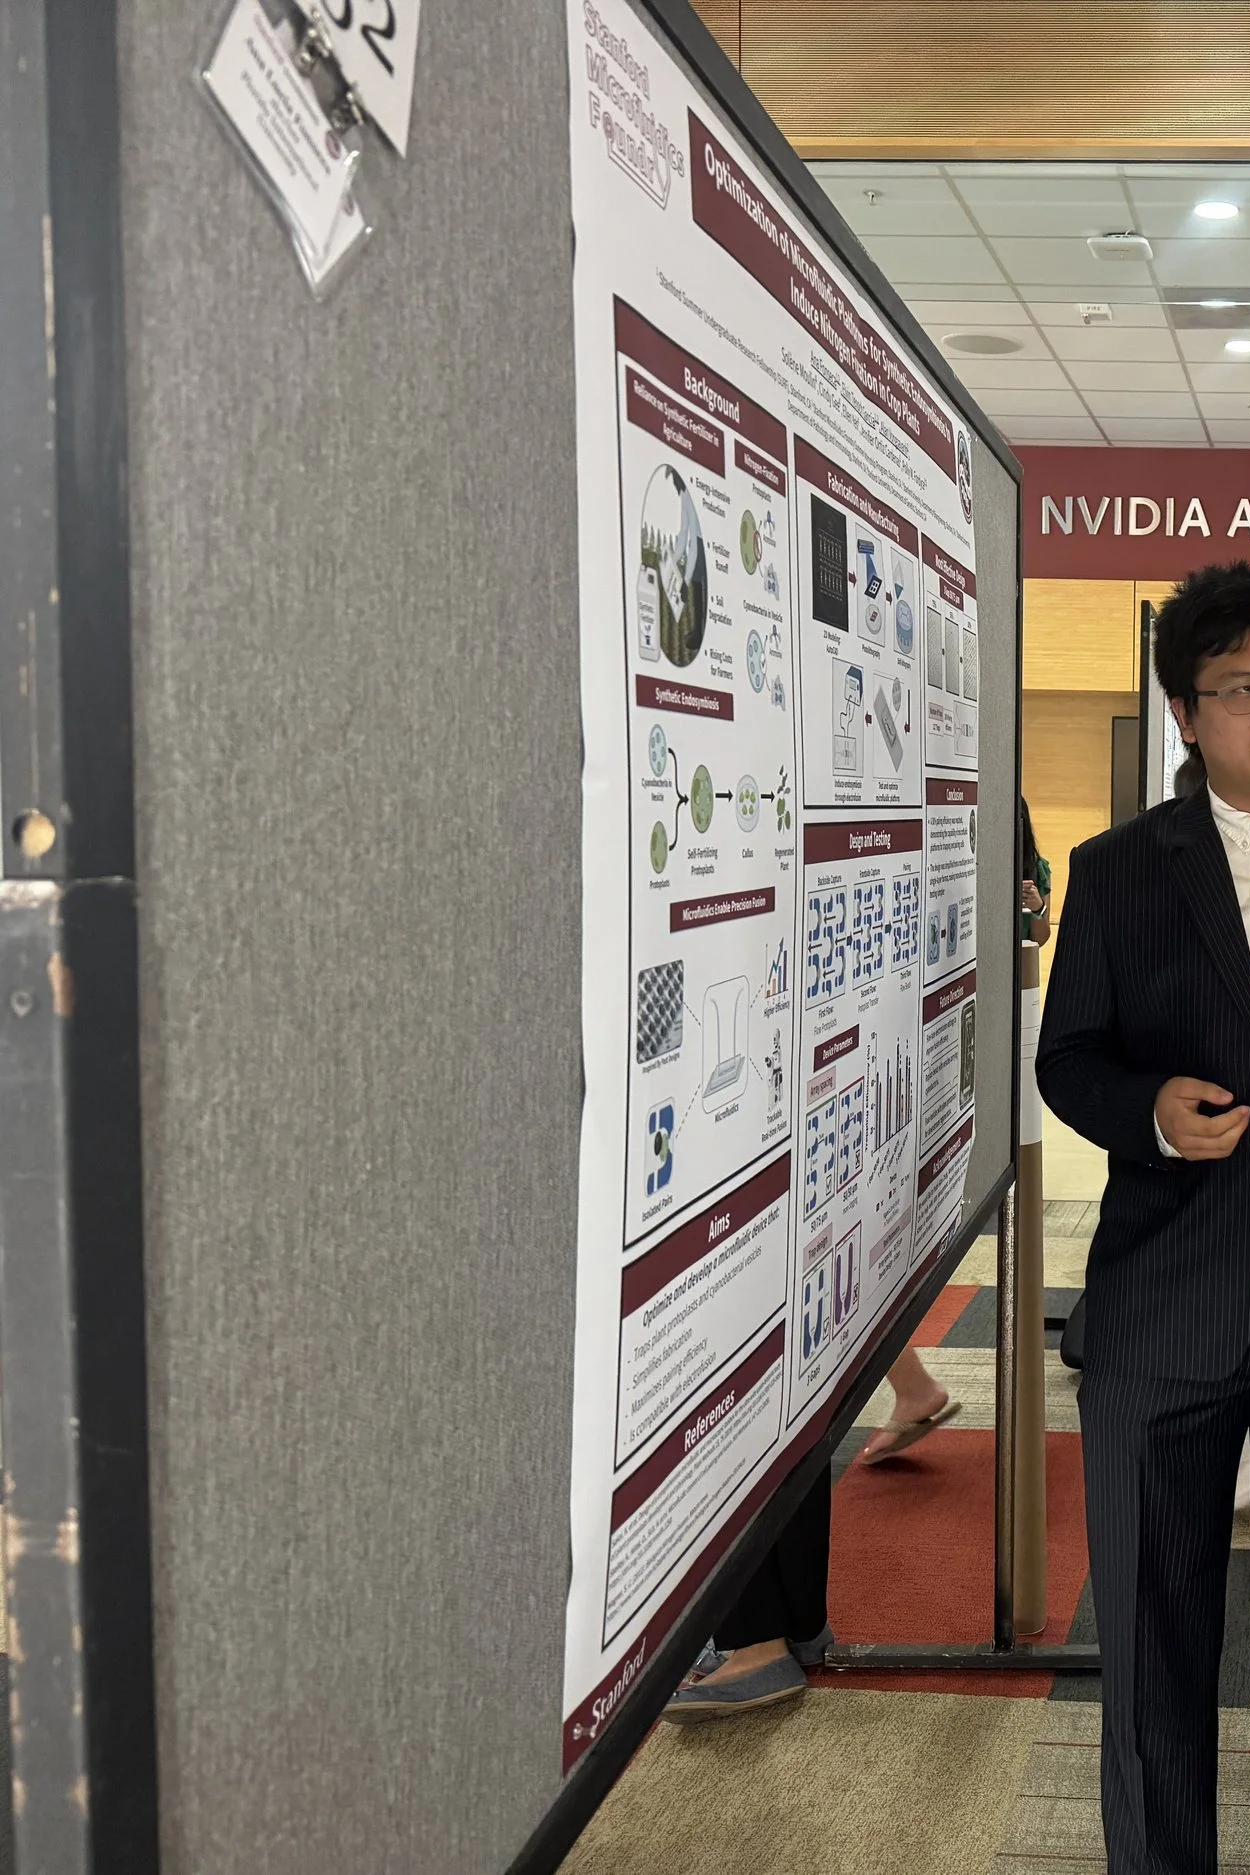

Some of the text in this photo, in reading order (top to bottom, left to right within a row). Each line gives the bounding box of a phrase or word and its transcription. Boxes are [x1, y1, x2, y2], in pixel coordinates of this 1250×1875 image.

[583, 0, 650, 101] Stanford
[585, 43, 684, 178] Microfluidics
[704, 143, 778, 247] Optimization
[779, 231, 790, 259] of
[790, 239, 838, 315] Microfluidic
[869, 336, 882, 365] for
[790, 276, 820, 330] Induce
[820, 309, 851, 364] Nitrogen
[851, 348, 878, 394] Fixation
[878, 373, 886, 403] in
[886, 384, 902, 422] Crop
[902, 399, 920, 436] Plants
[684, 366, 740, 425] Background
[663, 400, 688, 434] Synthetic
[689, 416, 712, 445] Fertilizer
[713, 432, 718, 448] in
[663, 419, 692, 455] Agriculture
[827, 470, 859, 510] Fabrication
[1041, 495, 1211, 538] NVIDIA
[655, 685, 719, 713] Synthetic Endosymbiosis
[741, 847, 753, 859] Callus
[849, 830, 890, 853] Design and Testing
[682, 894, 765, 922] Microfluidics Enable Precision Fusion
[823, 1033, 852, 1061] Device Parameters
[810, 1074, 832, 1099] Array spacing
[708, 1206, 730, 1244] Aims
[808, 1233, 827, 1263] Trap design
[642, 1203, 779, 1332] Optimize and develop a microfluidic device that:
[633, 1242, 761, 1366] Traps plant protoplasts and cyanobacterial vesicles
[631, 1333, 707, 1419] Maximizes pairing efficiency
[632, 1323, 692, 1393] Simplifies fabrication
[629, 1346, 716, 1444] Is compatible with electrofusion
[684, 1379, 735, 1458] References
[590, 1636, 648, 1738] Stanford
